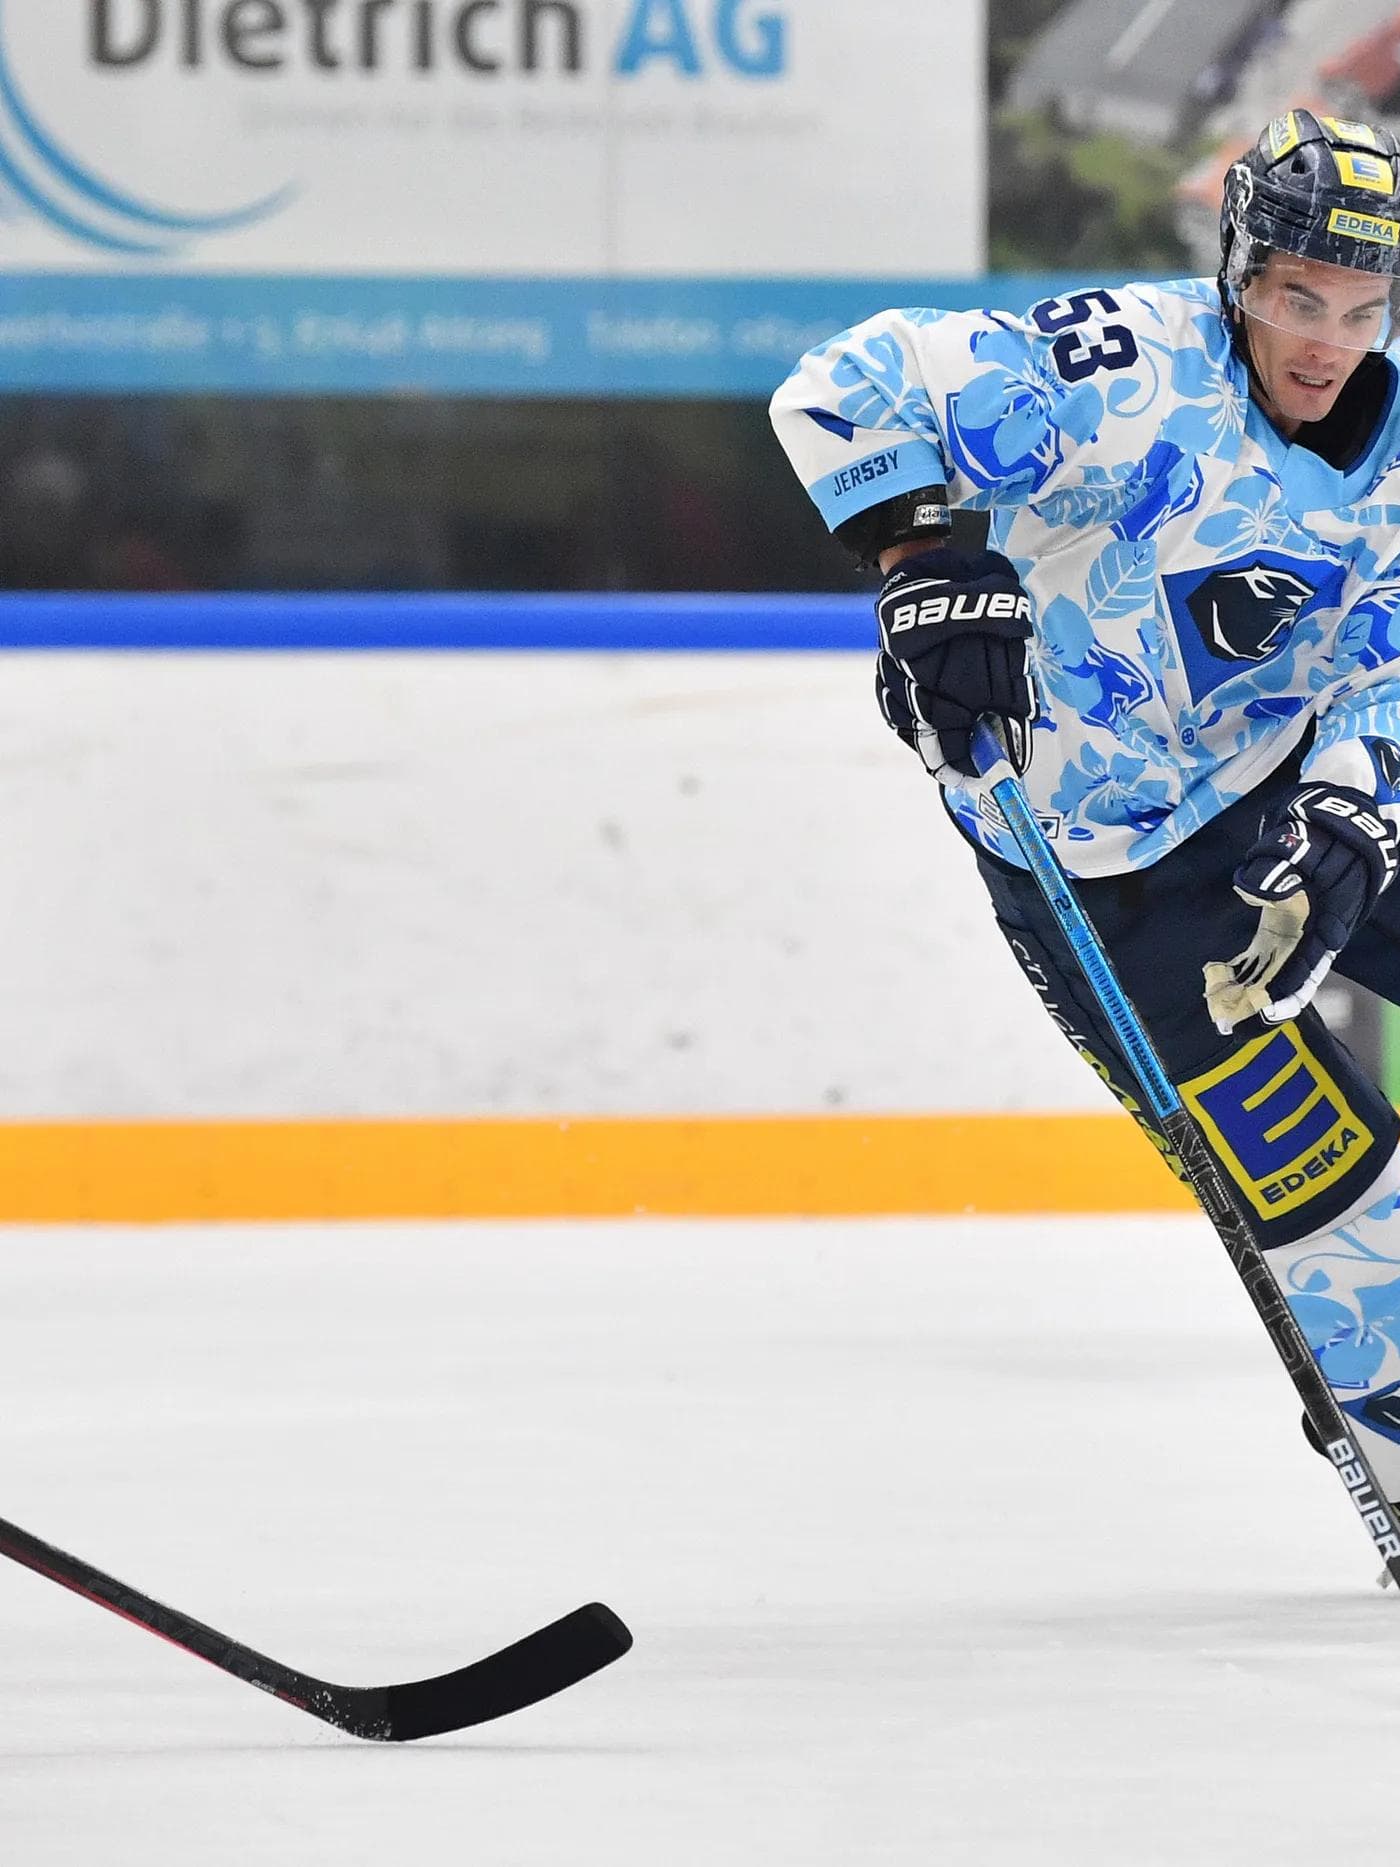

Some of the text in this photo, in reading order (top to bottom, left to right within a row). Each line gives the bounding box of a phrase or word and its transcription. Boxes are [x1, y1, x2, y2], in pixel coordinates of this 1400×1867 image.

[84, 0, 793, 79] Dietrich AG
[1335, 214, 1394, 238] EDEKA
[1031, 288, 1139, 383] 53
[834, 449, 899, 497] JER53Y
[1313, 796, 1399, 896] BAU
[1258, 1126, 1359, 1206] EDEKA
